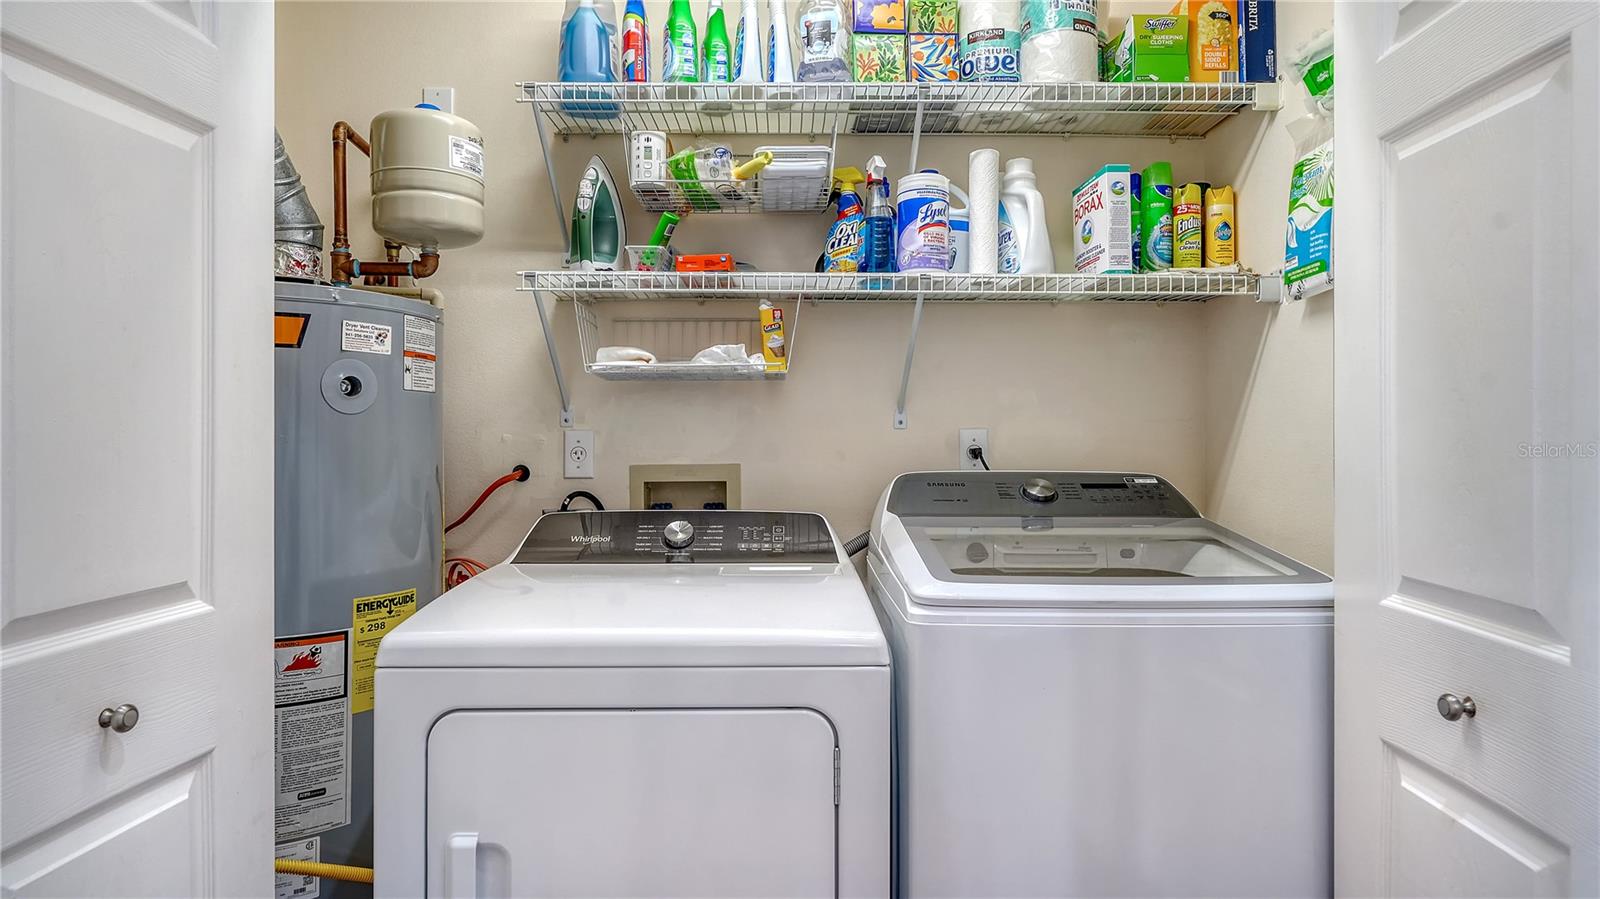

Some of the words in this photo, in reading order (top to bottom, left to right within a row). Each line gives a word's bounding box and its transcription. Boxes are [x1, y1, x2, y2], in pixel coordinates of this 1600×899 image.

[1248, 1, 1258, 31] BRITA
[1145, 17, 1177, 30] Swiffer
[969, 29, 1003, 39] KIRKLAND
[920, 203, 947, 222] Lysol
[1074, 192, 1104, 226] BORAX
[836, 222, 857, 238] OXI
[371, 325, 390, 333] Cleaning
[570, 535, 611, 544] Whirlpool
[356, 593, 415, 613] ENERGYGUIDE
[367, 621, 386, 632] 298
